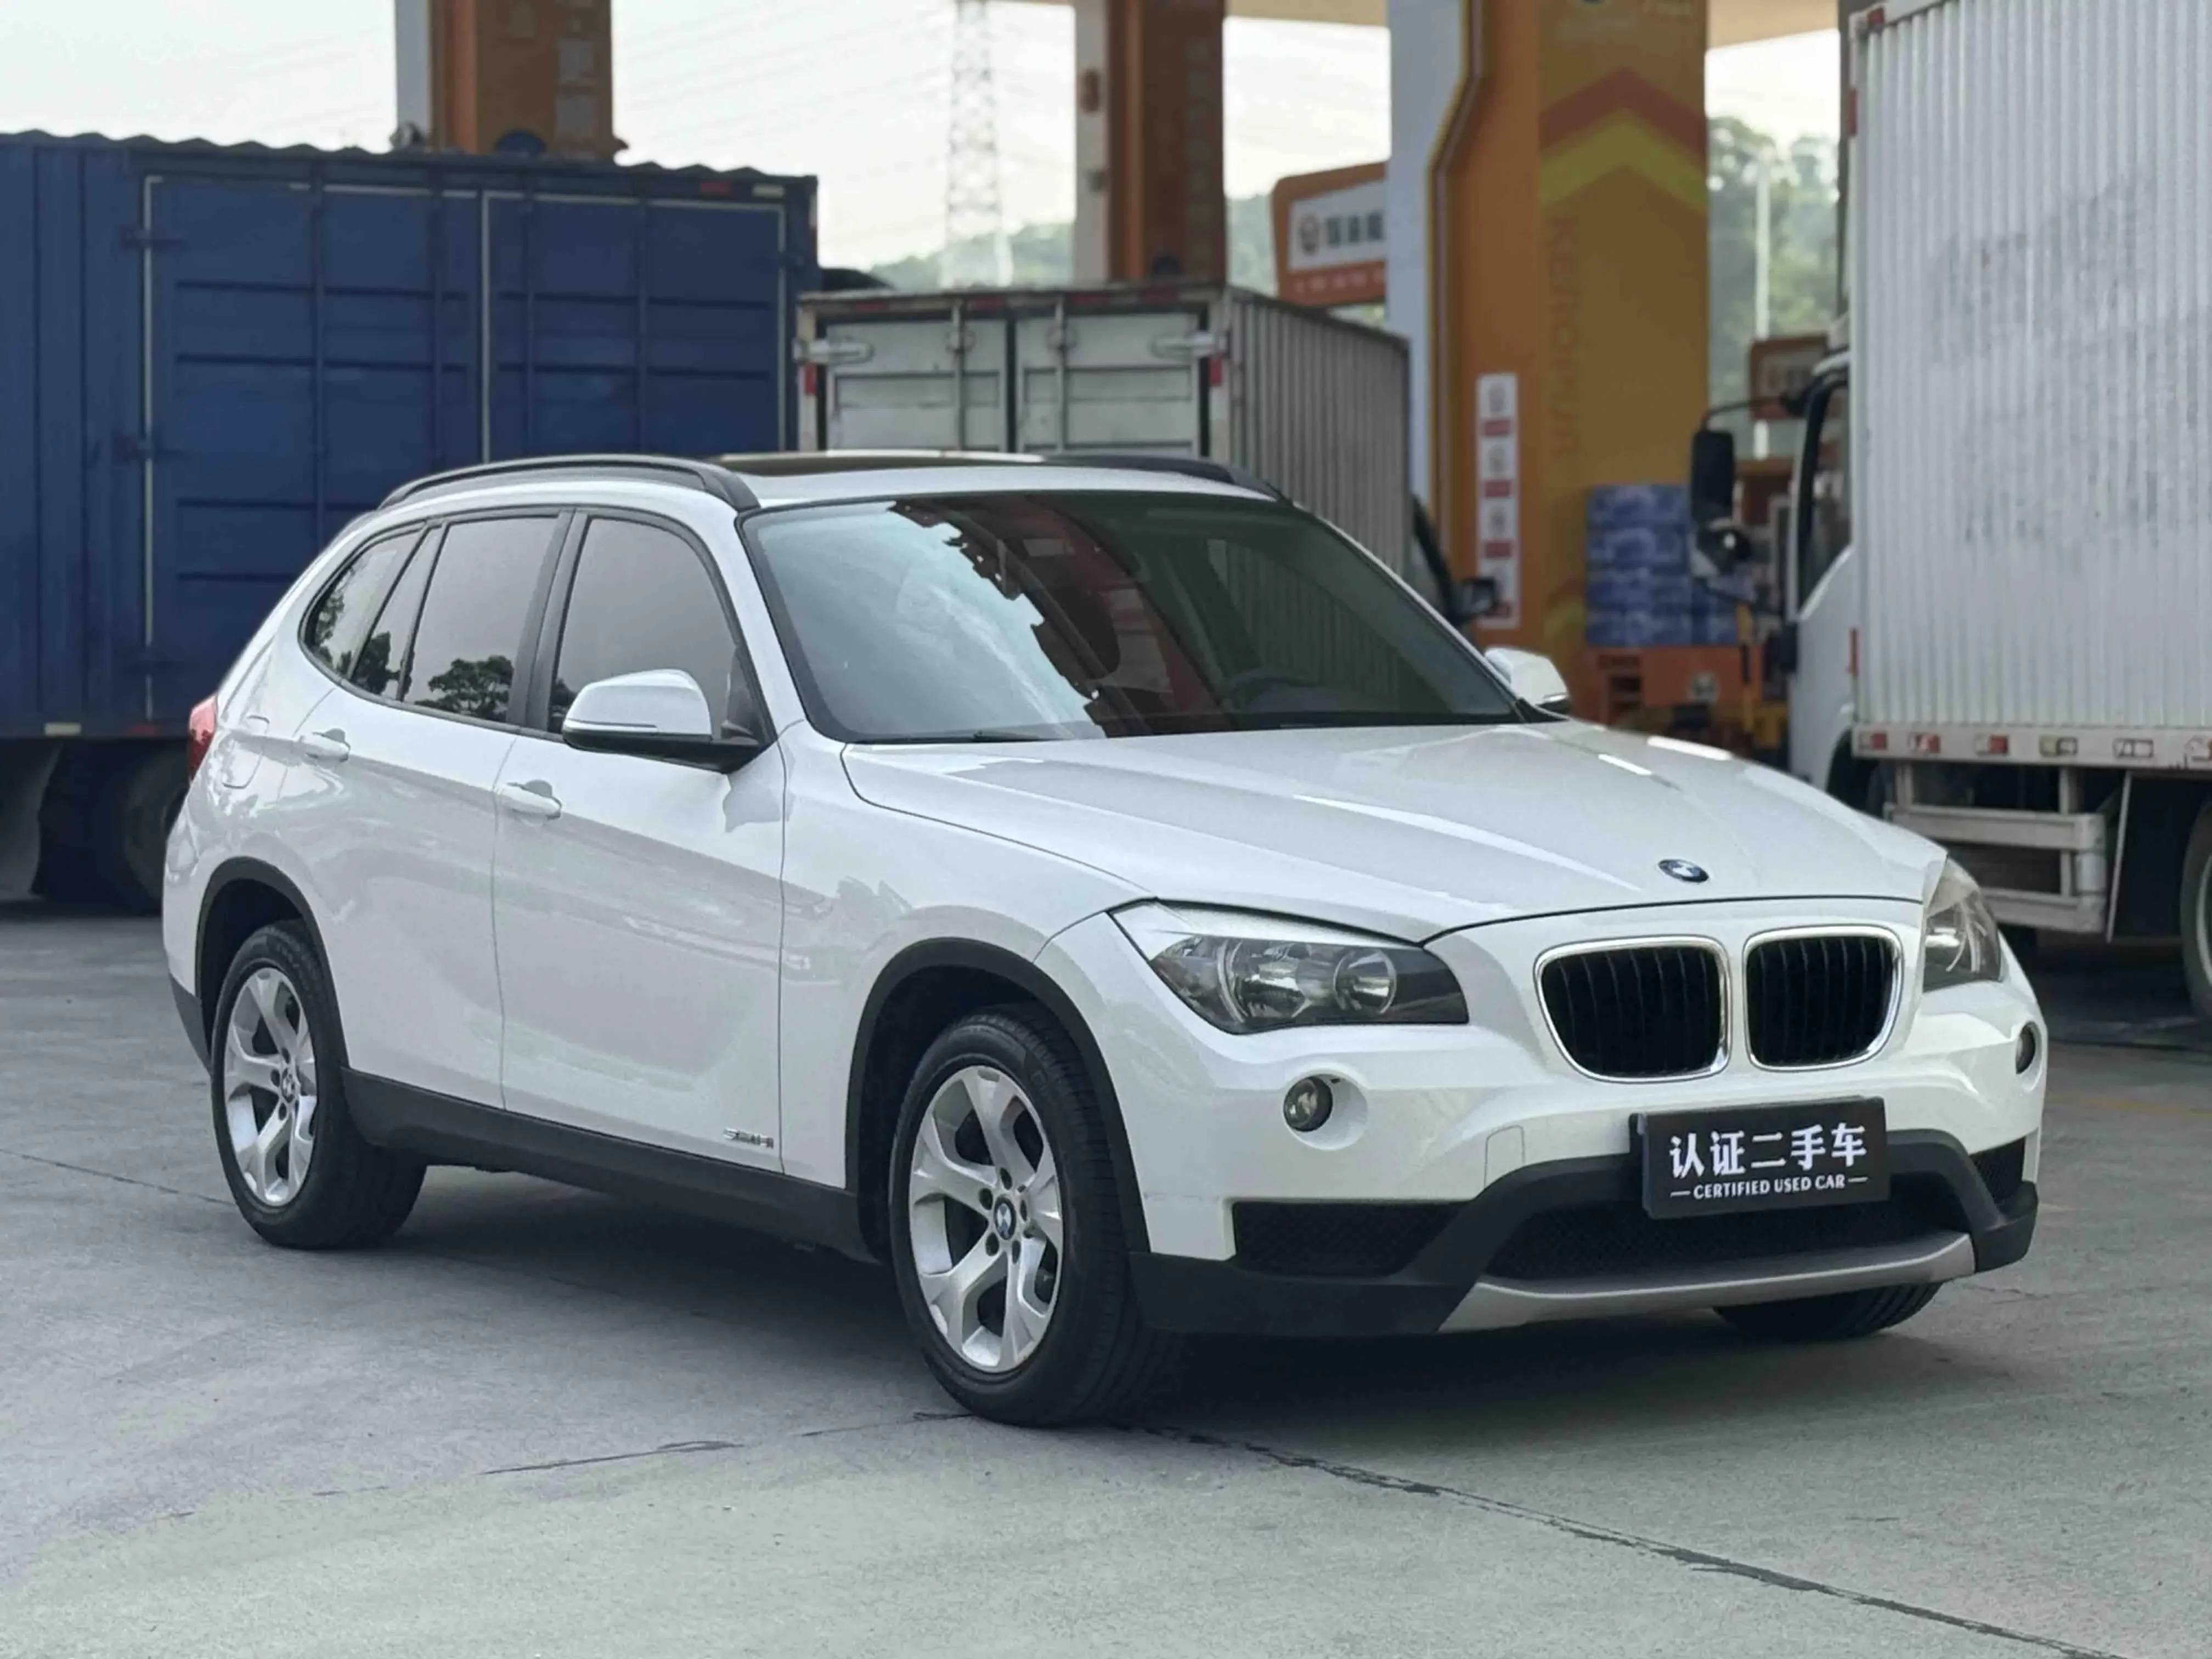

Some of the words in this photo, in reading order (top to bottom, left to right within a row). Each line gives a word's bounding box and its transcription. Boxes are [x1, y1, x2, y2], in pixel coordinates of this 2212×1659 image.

[1669, 1122, 1867, 1178] 认证二手车
[1693, 1180, 1770, 1199] CERTIFIED
[1774, 1177, 1812, 1193] USED
[1815, 1174, 1846, 1190] CAR
